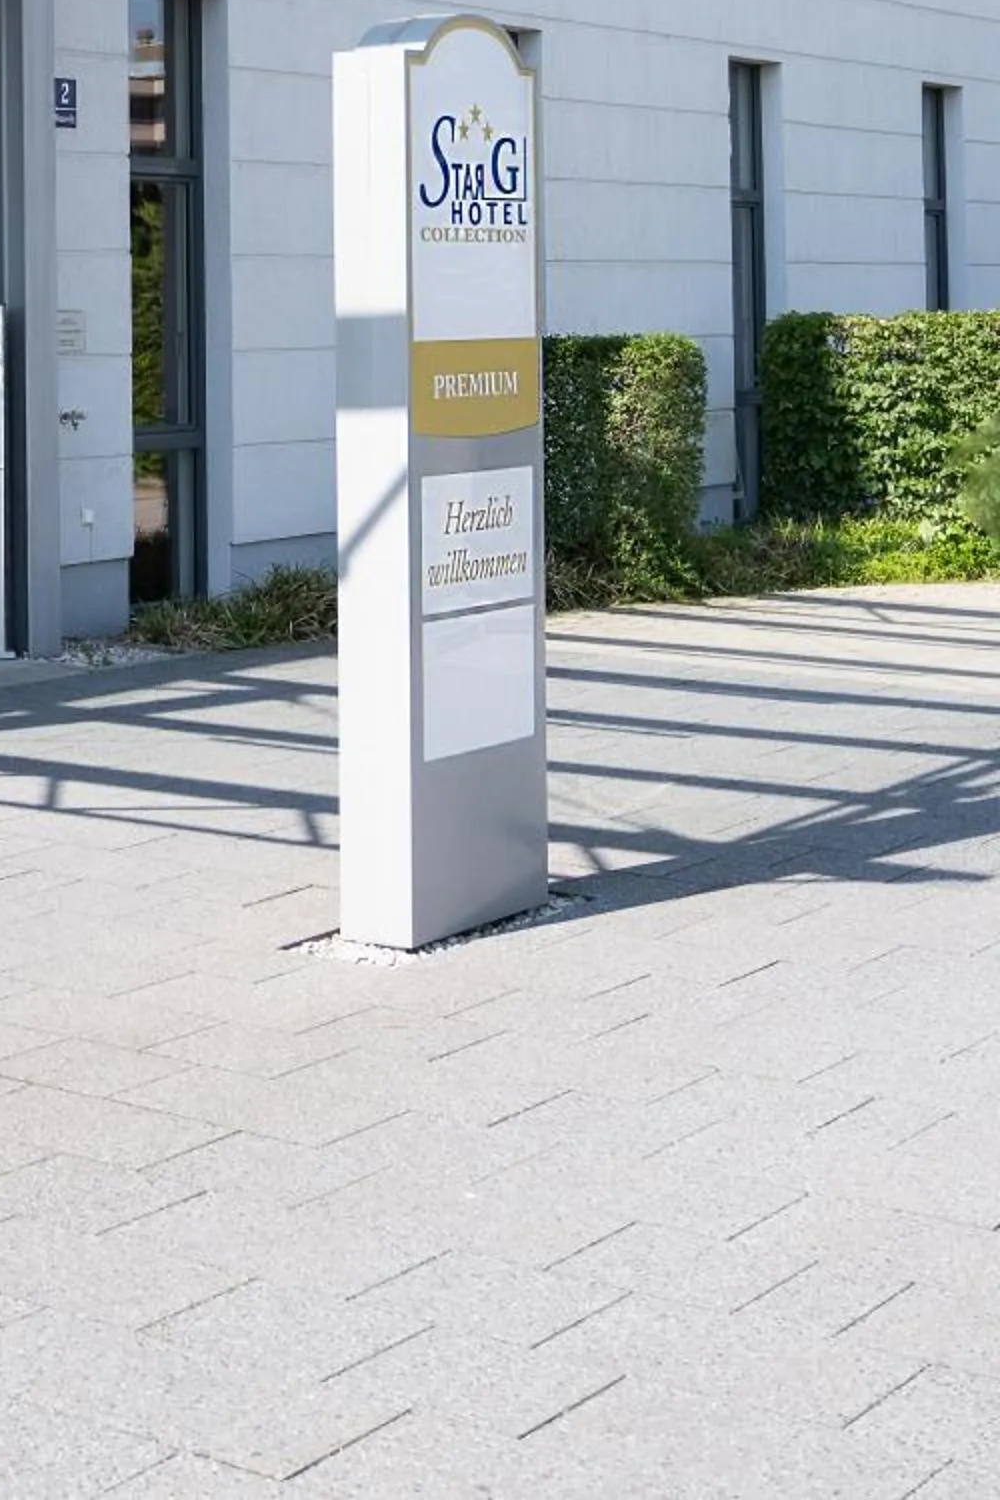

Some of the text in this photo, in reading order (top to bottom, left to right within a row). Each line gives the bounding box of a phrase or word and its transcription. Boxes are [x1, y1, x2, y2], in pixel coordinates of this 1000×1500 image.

[61, 83, 69, 105] 2
[451, 201, 528, 226] HOTEL
[420, 227, 527, 243] COLLECTION
[433, 370, 518, 399] PREMIUM
[443, 493, 514, 536] Herzlich
[427, 547, 528, 588] willkommen
